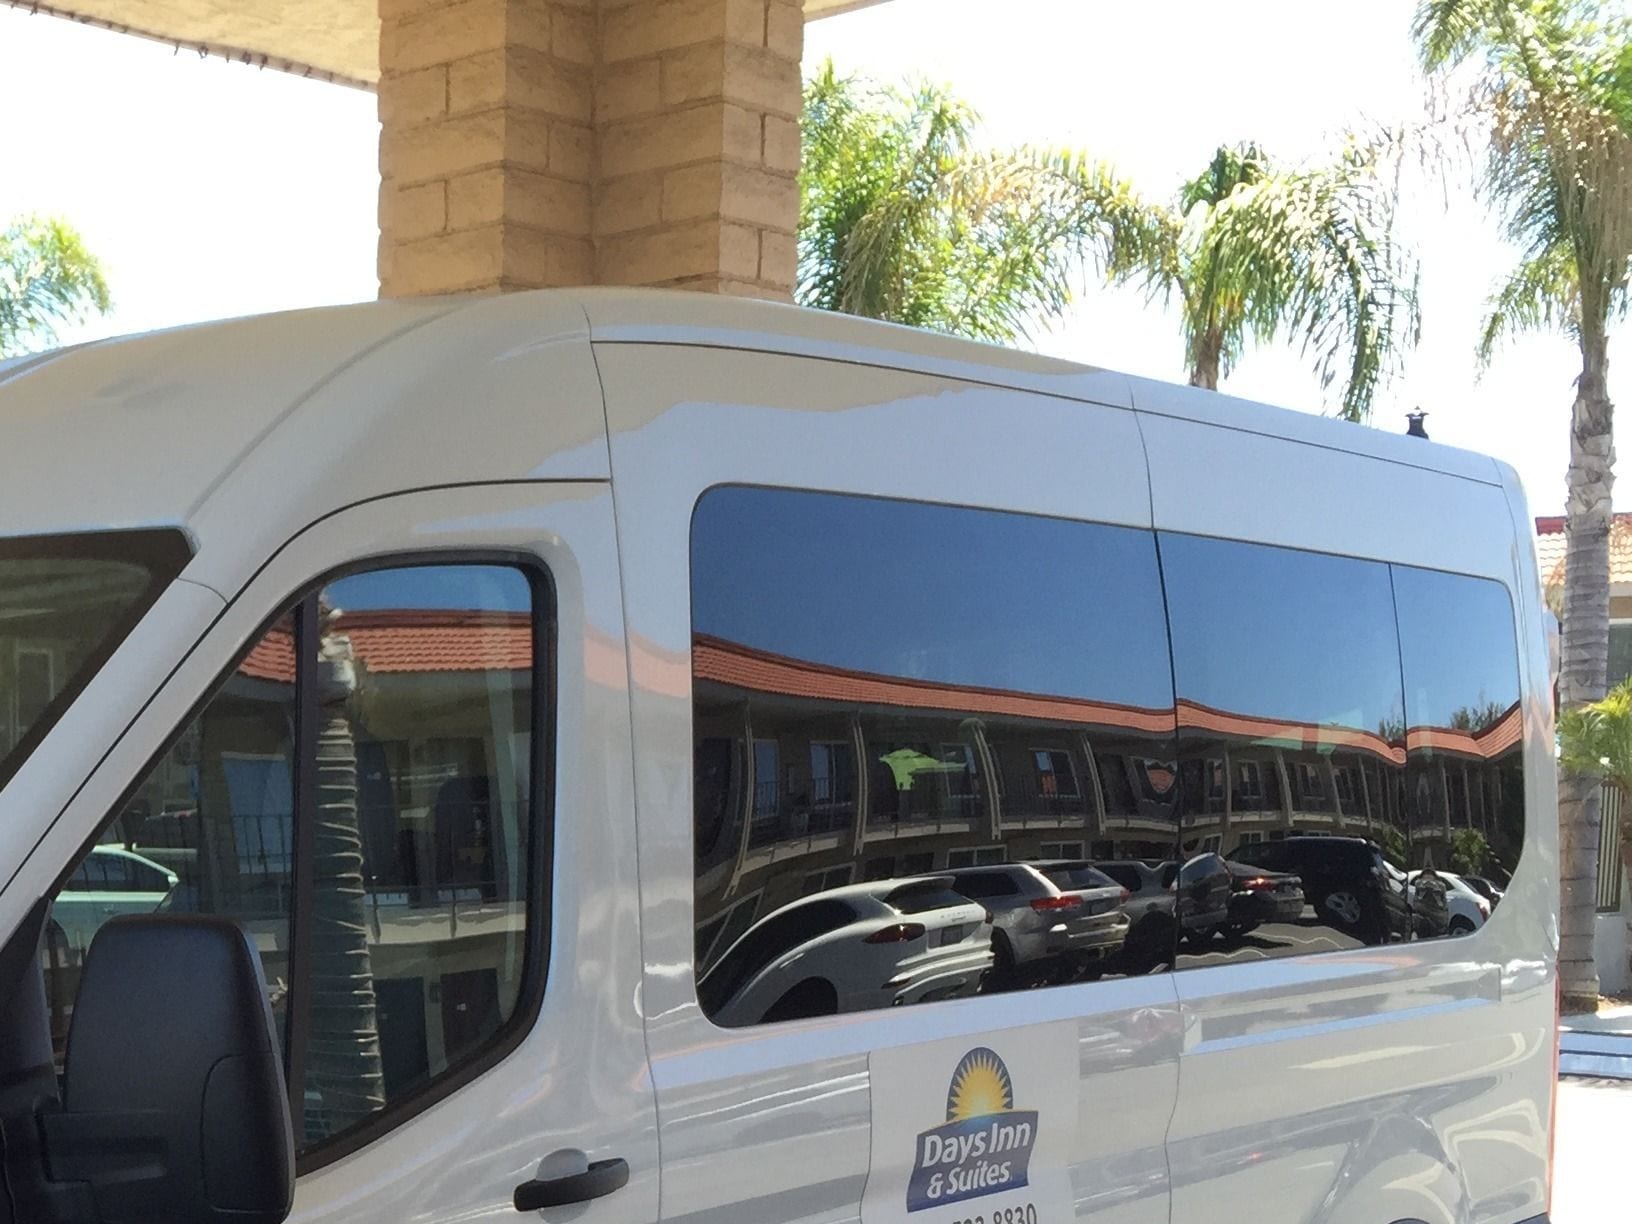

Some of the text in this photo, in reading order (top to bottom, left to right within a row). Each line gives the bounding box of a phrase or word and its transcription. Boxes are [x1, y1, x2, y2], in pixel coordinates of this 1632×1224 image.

[922, 1122, 1031, 1168] Days Inn
[927, 1160, 1011, 1198] & Suites
